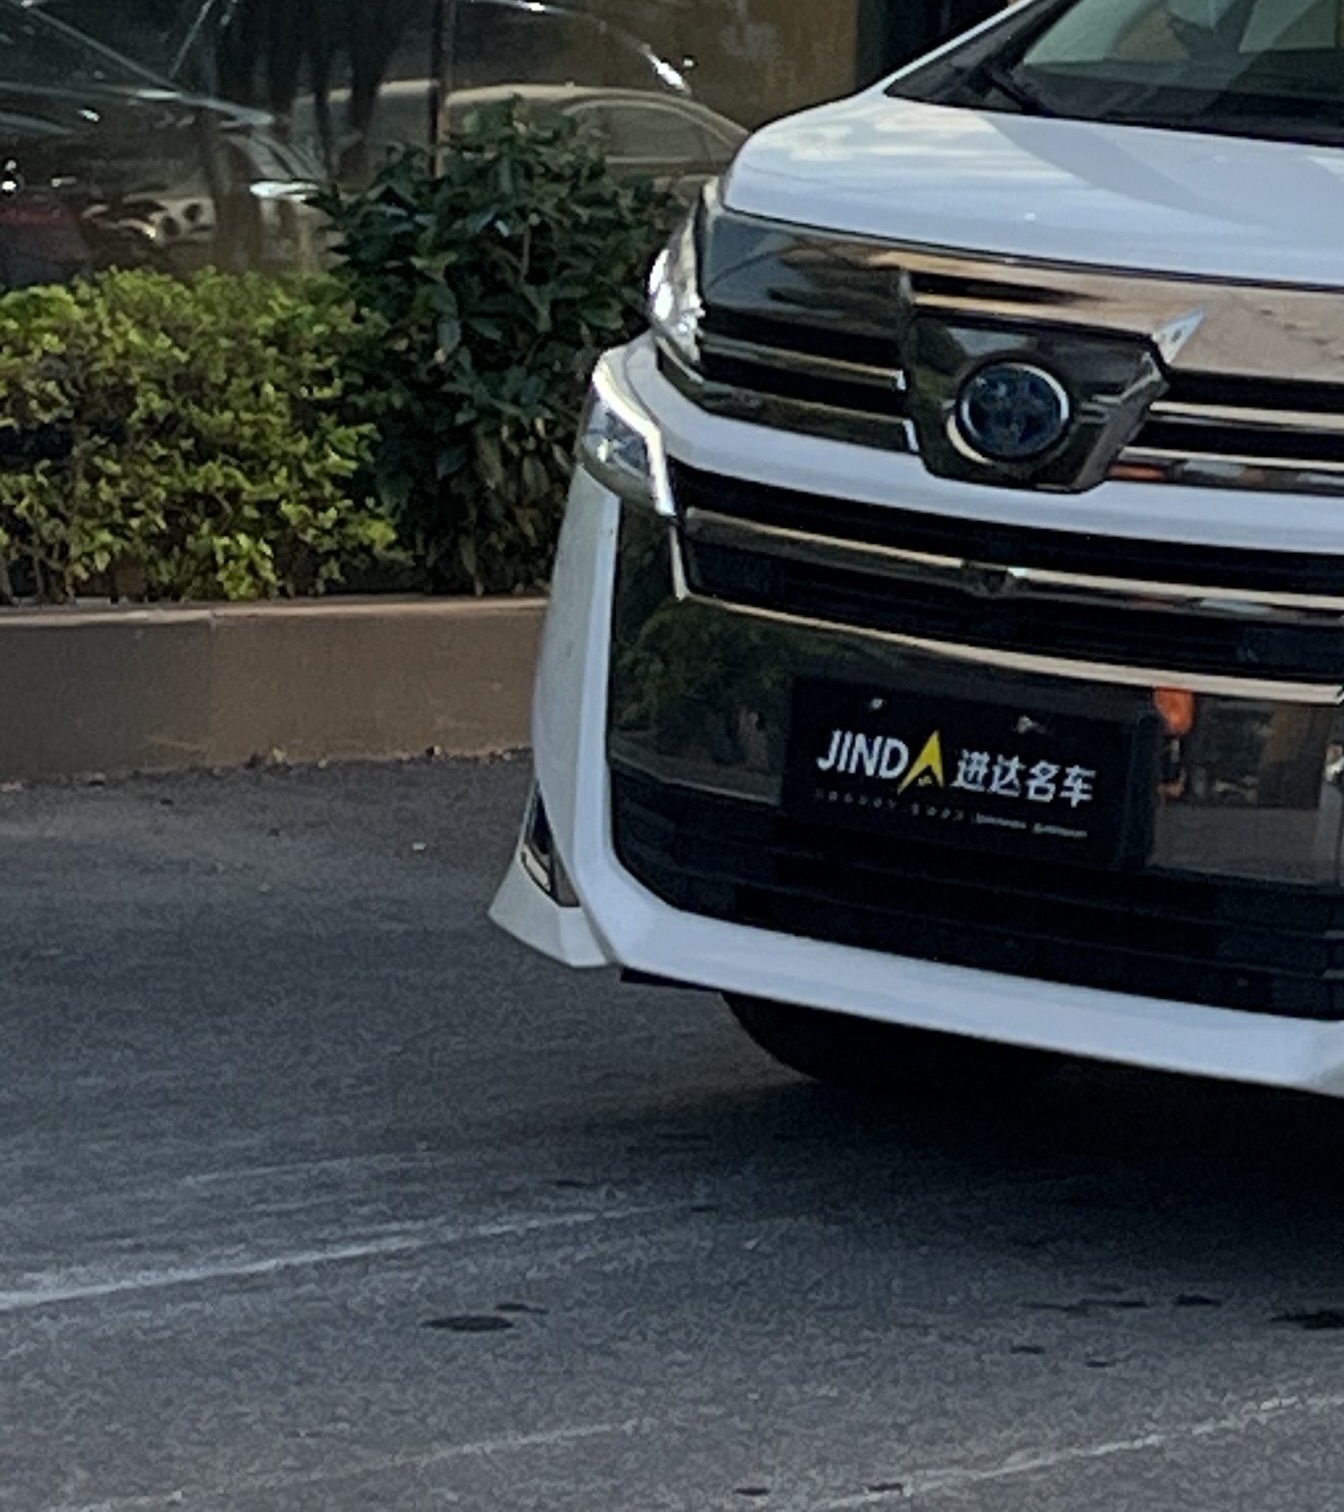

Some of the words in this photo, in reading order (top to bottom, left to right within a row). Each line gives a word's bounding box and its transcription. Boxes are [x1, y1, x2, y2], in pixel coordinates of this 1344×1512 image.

[817, 729, 945, 795] JINDA
[951, 748, 1096, 808] 进达名车
